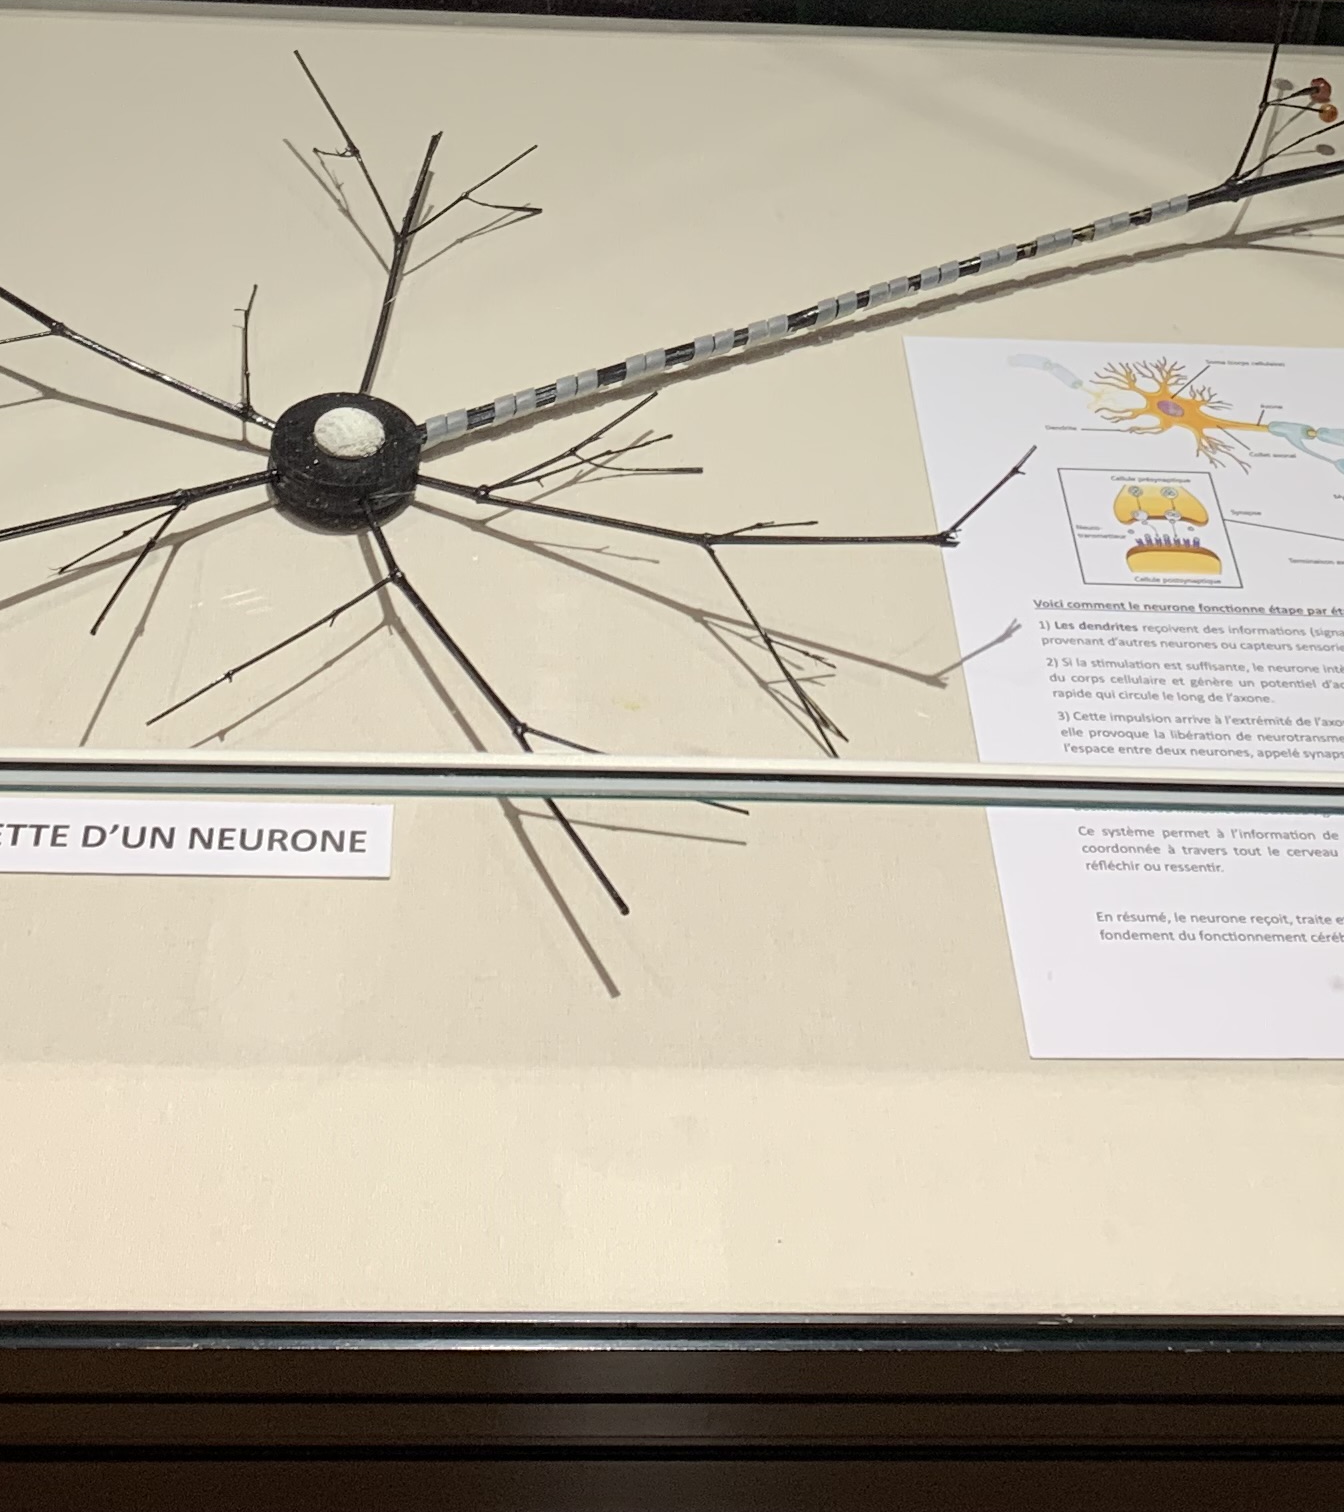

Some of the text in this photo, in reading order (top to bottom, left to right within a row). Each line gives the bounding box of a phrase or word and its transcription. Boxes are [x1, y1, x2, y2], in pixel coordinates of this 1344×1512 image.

[1032, 599, 1064, 609] Voici
[1066, 601, 1126, 610] comment
[1128, 601, 1140, 611] le
[1143, 603, 1195, 612] neurone
[1198, 602, 1265, 613] fonctionne
[1268, 604, 1304, 614] étape
[1306, 607, 1327, 615] par
[1038, 619, 1051, 632] 1)
[1053, 620, 1075, 630] Les
[1078, 620, 1139, 632] dendrites
[1141, 623, 1199, 635] reçoivent
[1202, 624, 1225, 634] des
[1227, 624, 1306, 637] informations
[81, 824, 176, 850] D'UN
[188, 827, 368, 854] NEURONE
[1077, 826, 1095, 836] Ce
[1101, 826, 1155, 838] système
[1161, 829, 1210, 840] permet
[1216, 828, 1225, 839] à
[1230, 828, 1317, 841] l'information
[1322, 830, 1339, 840] de
[1095, 911, 1113, 922] En
[1116, 911, 1171, 925] résumé,
[1173, 911, 1187, 924] le
[1189, 914, 1247, 924] neurone
[1249, 913, 1293, 927] reçoit,
[1295, 914, 1332, 925] traite
